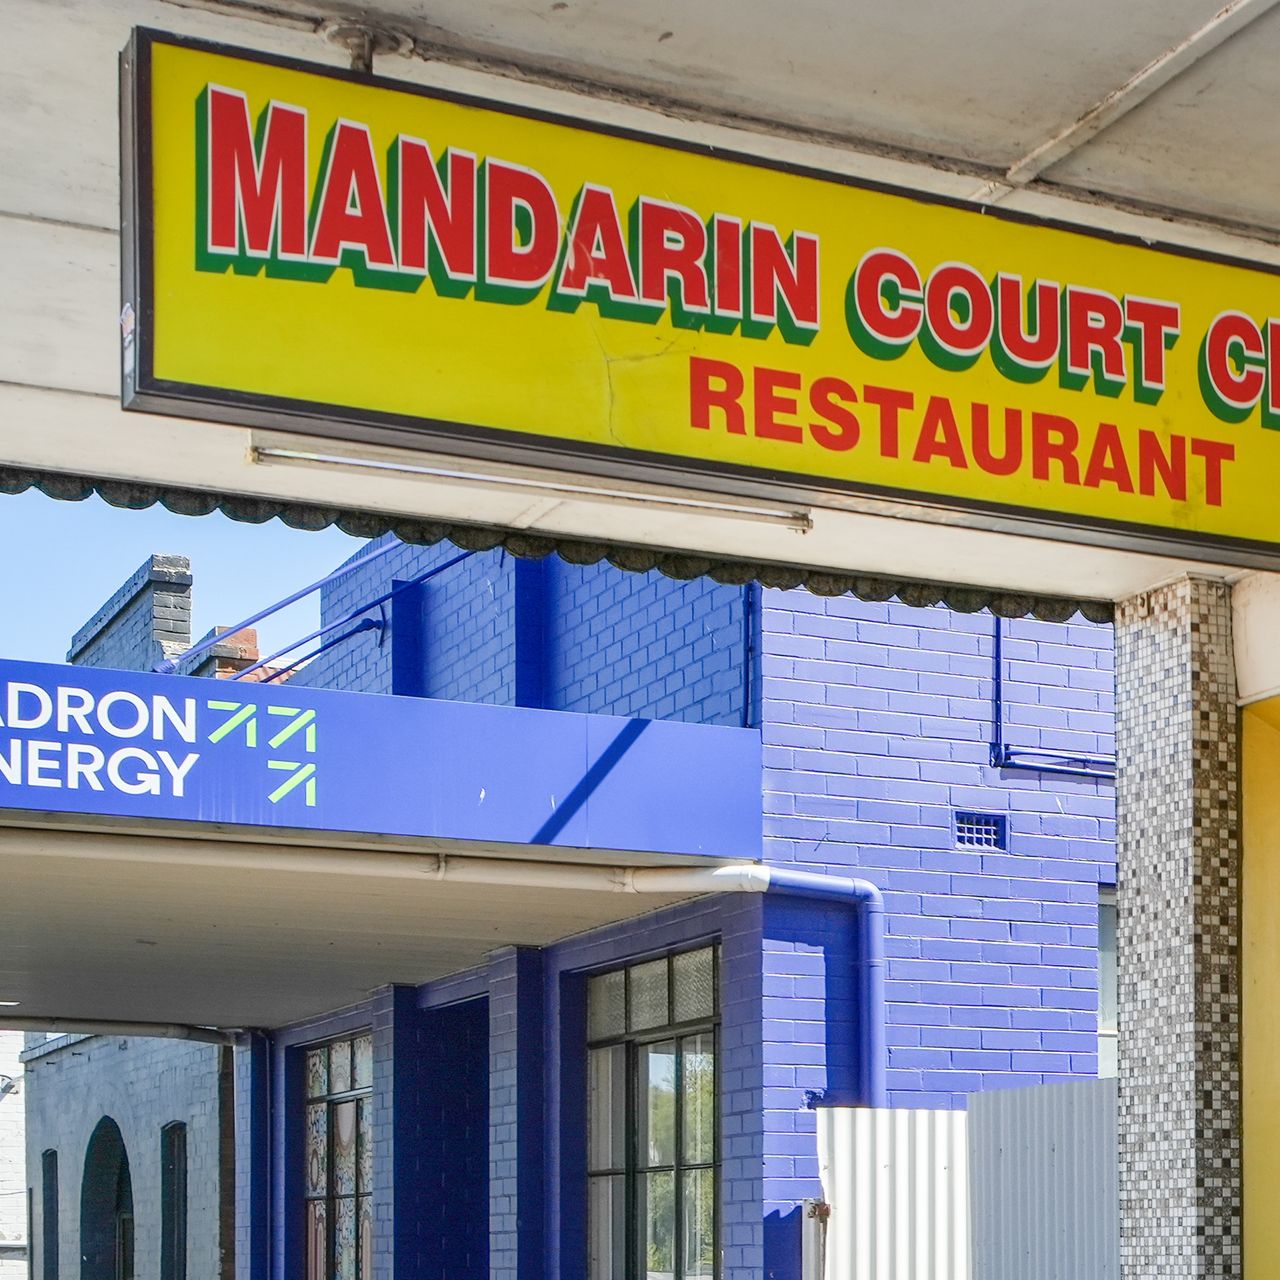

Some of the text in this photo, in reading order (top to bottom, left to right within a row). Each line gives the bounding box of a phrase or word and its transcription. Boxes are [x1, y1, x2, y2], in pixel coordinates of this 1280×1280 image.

[197, 83, 821, 345] MANDARIN
[846, 246, 1181, 404] COURT
[689, 356, 1235, 507] RESTAURANT
[0, 681, 197, 743] DRON
